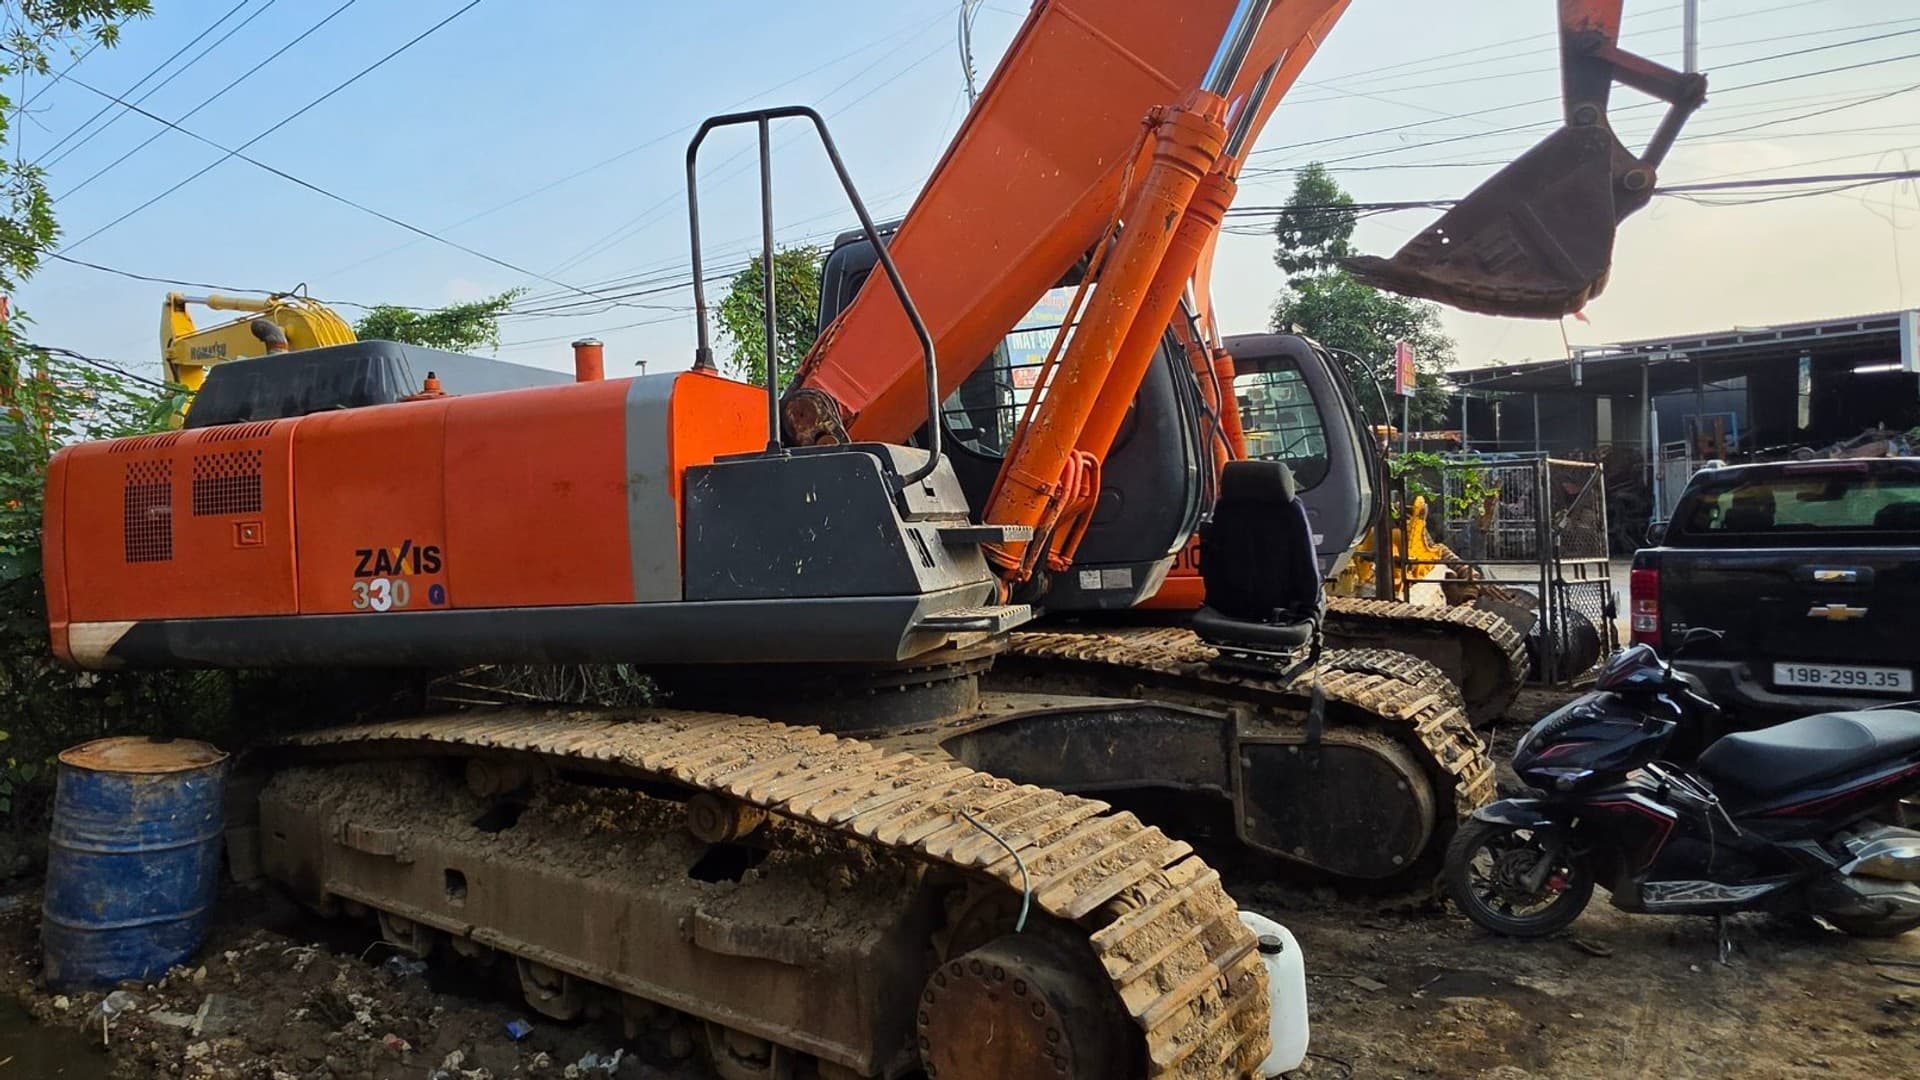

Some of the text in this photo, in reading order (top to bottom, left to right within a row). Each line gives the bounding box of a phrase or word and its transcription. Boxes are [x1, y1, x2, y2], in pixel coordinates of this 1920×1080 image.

[354, 539, 442, 577] ZAXIS
[352, 577, 410, 612] 330
[1787, 667, 1900, 687] 19B-299.35
